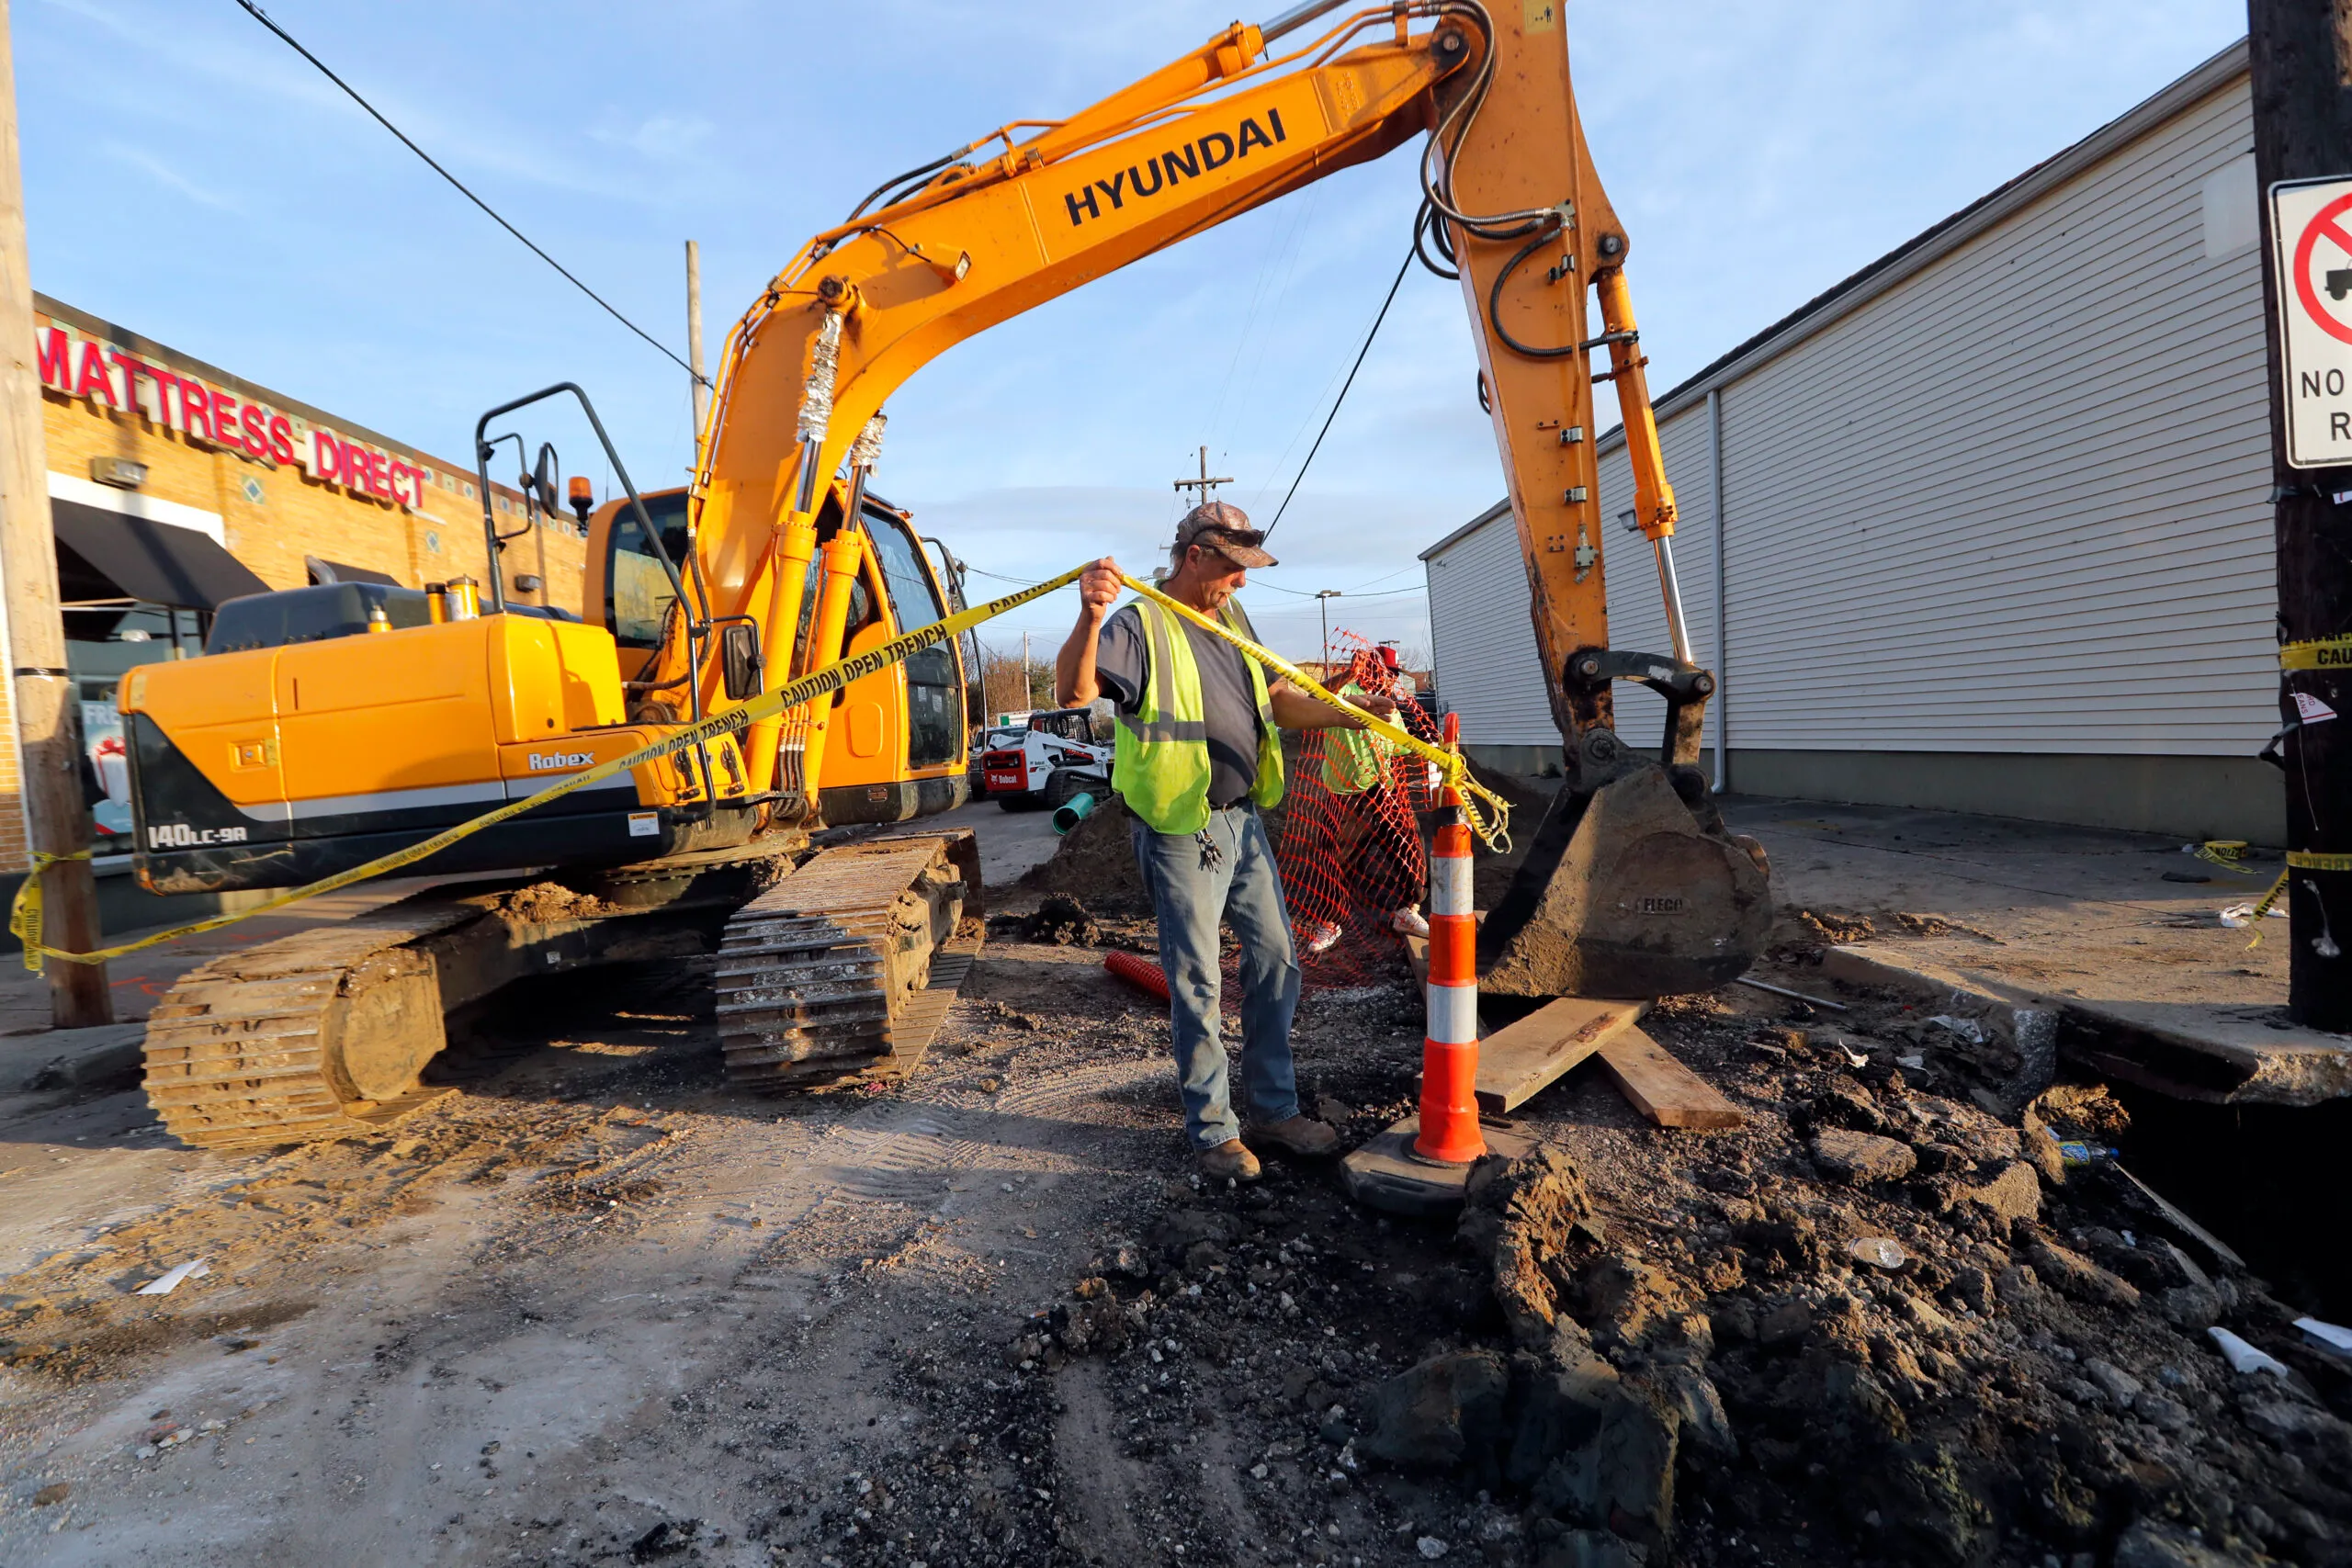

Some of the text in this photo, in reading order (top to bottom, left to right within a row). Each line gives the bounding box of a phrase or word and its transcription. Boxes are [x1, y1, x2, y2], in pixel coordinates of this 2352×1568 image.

[1064, 107, 1287, 227] HYUNDAI
[2301, 367, 2345, 399] NO
[36, 326, 426, 508] MATTRESS DIRECT
[780, 623, 948, 708] CAUTION OPEN TRENCH
[528, 750, 595, 771] Robex
[618, 708, 750, 770] CAUTION OPEN TRENCH
[999, 774, 1017, 784] Bobcat
